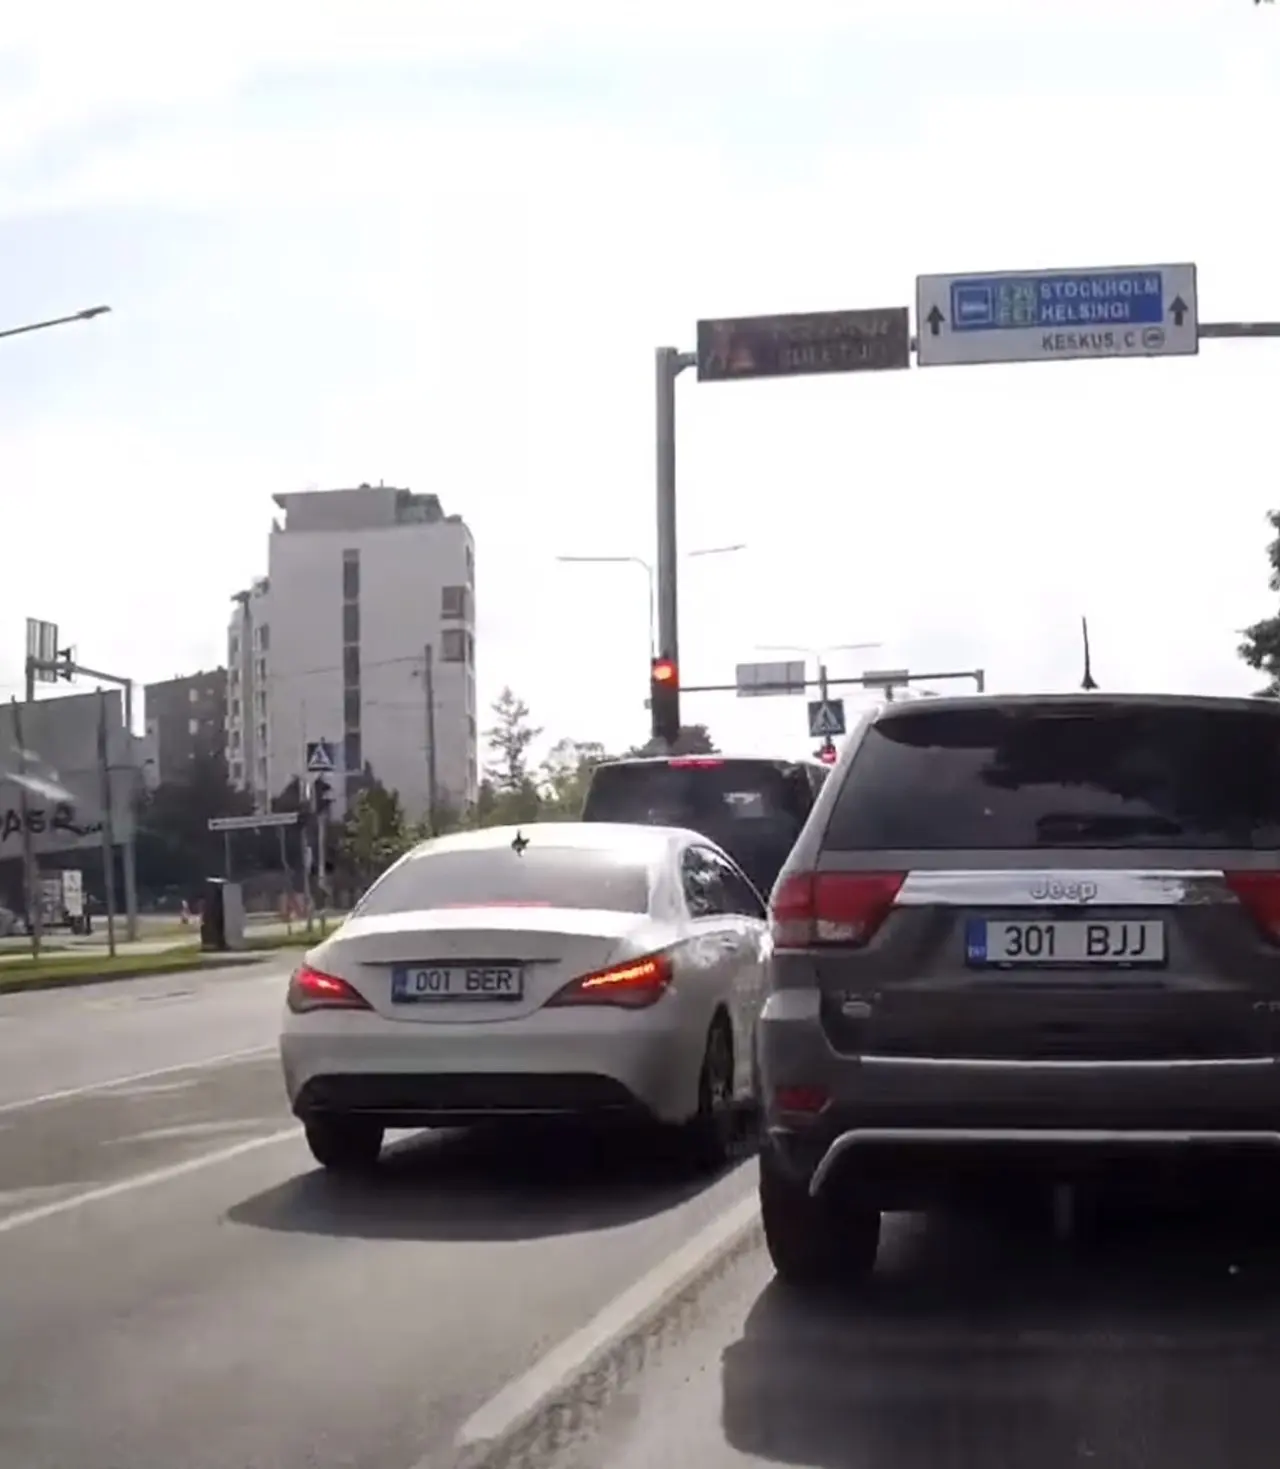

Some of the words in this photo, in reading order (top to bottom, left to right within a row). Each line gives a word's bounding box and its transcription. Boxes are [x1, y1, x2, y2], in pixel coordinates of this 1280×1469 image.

[1041, 278, 1159, 299] STOCKHOLM
[1042, 301, 1130, 321] HELSINGI
[1031, 876, 1098, 902] Jeep
[1004, 925, 1056, 957] 301
[1086, 925, 1146, 957] BJJ
[416, 970, 450, 992] 001
[465, 969, 512, 991] BER
